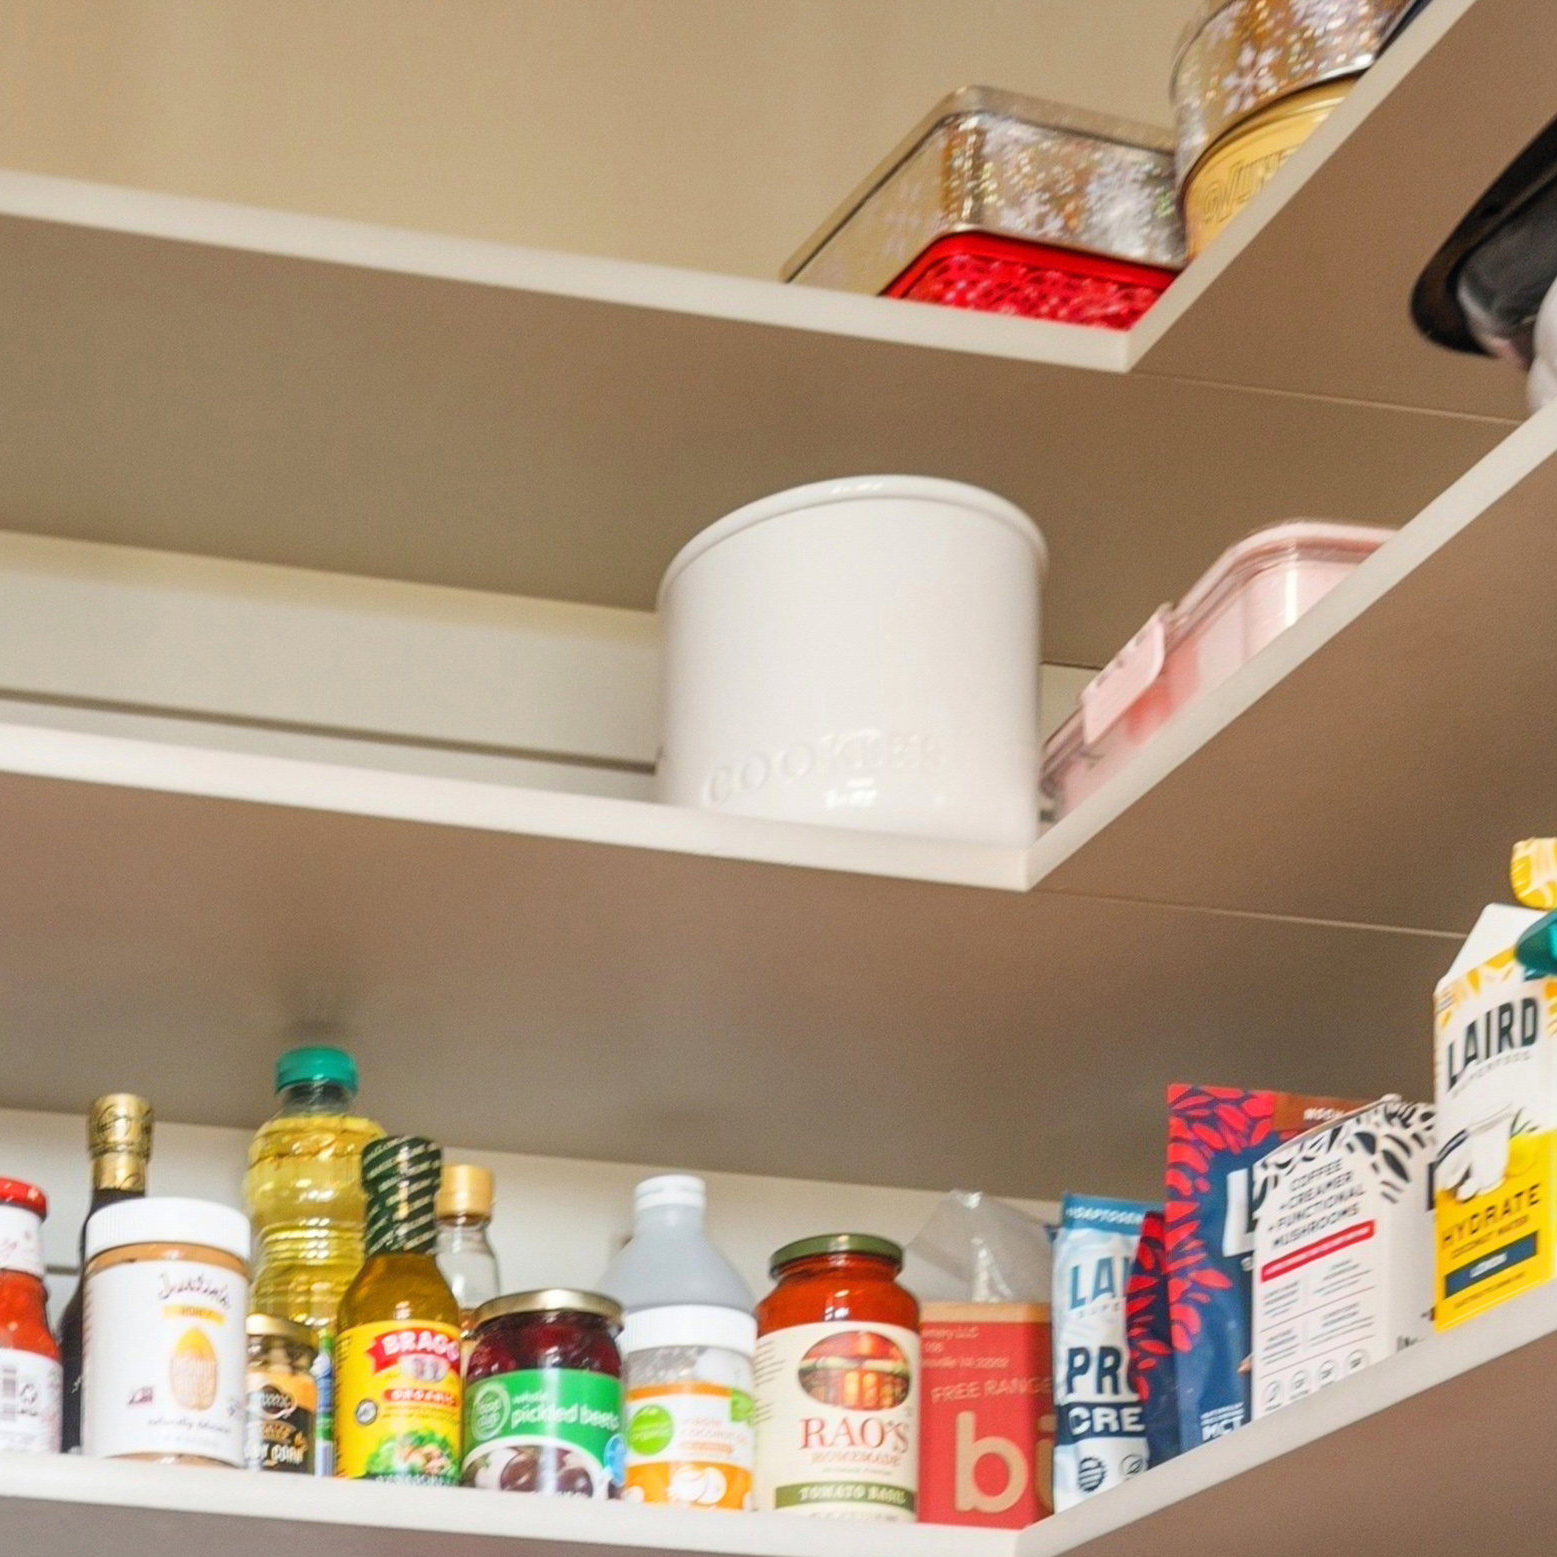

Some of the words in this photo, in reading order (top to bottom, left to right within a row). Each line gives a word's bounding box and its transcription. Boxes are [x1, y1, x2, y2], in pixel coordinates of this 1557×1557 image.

[1446, 998, 1538, 1092] LAIRD
[1291, 1158, 1341, 1193] COFFEE
[1273, 1203, 1359, 1247] MUSHROOMS
[1441, 1184, 1541, 1247] HYDRATE
[931, 1375, 982, 1404] FREE
[985, 1377, 1051, 1397] RANGE
[511, 1405, 578, 1429] pickled
[580, 1407, 619, 1429] beets
[799, 1417, 909, 1452] RAO'S
[799, 1486, 864, 1502] TOMATO
